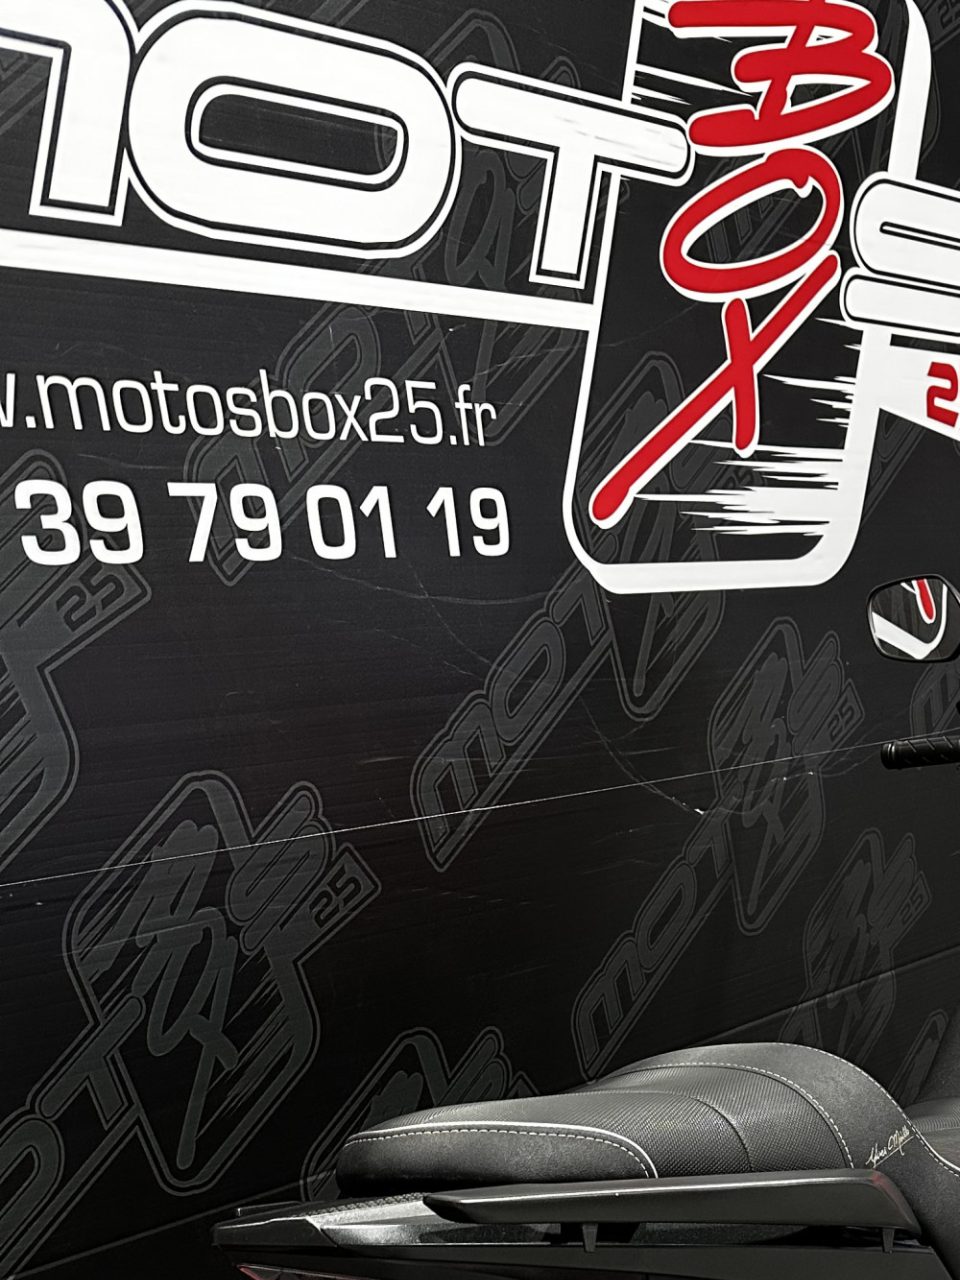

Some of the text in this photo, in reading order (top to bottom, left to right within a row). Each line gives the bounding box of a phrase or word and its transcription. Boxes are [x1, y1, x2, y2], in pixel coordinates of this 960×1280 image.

[14, 479, 511, 566] 39 79 01 19
